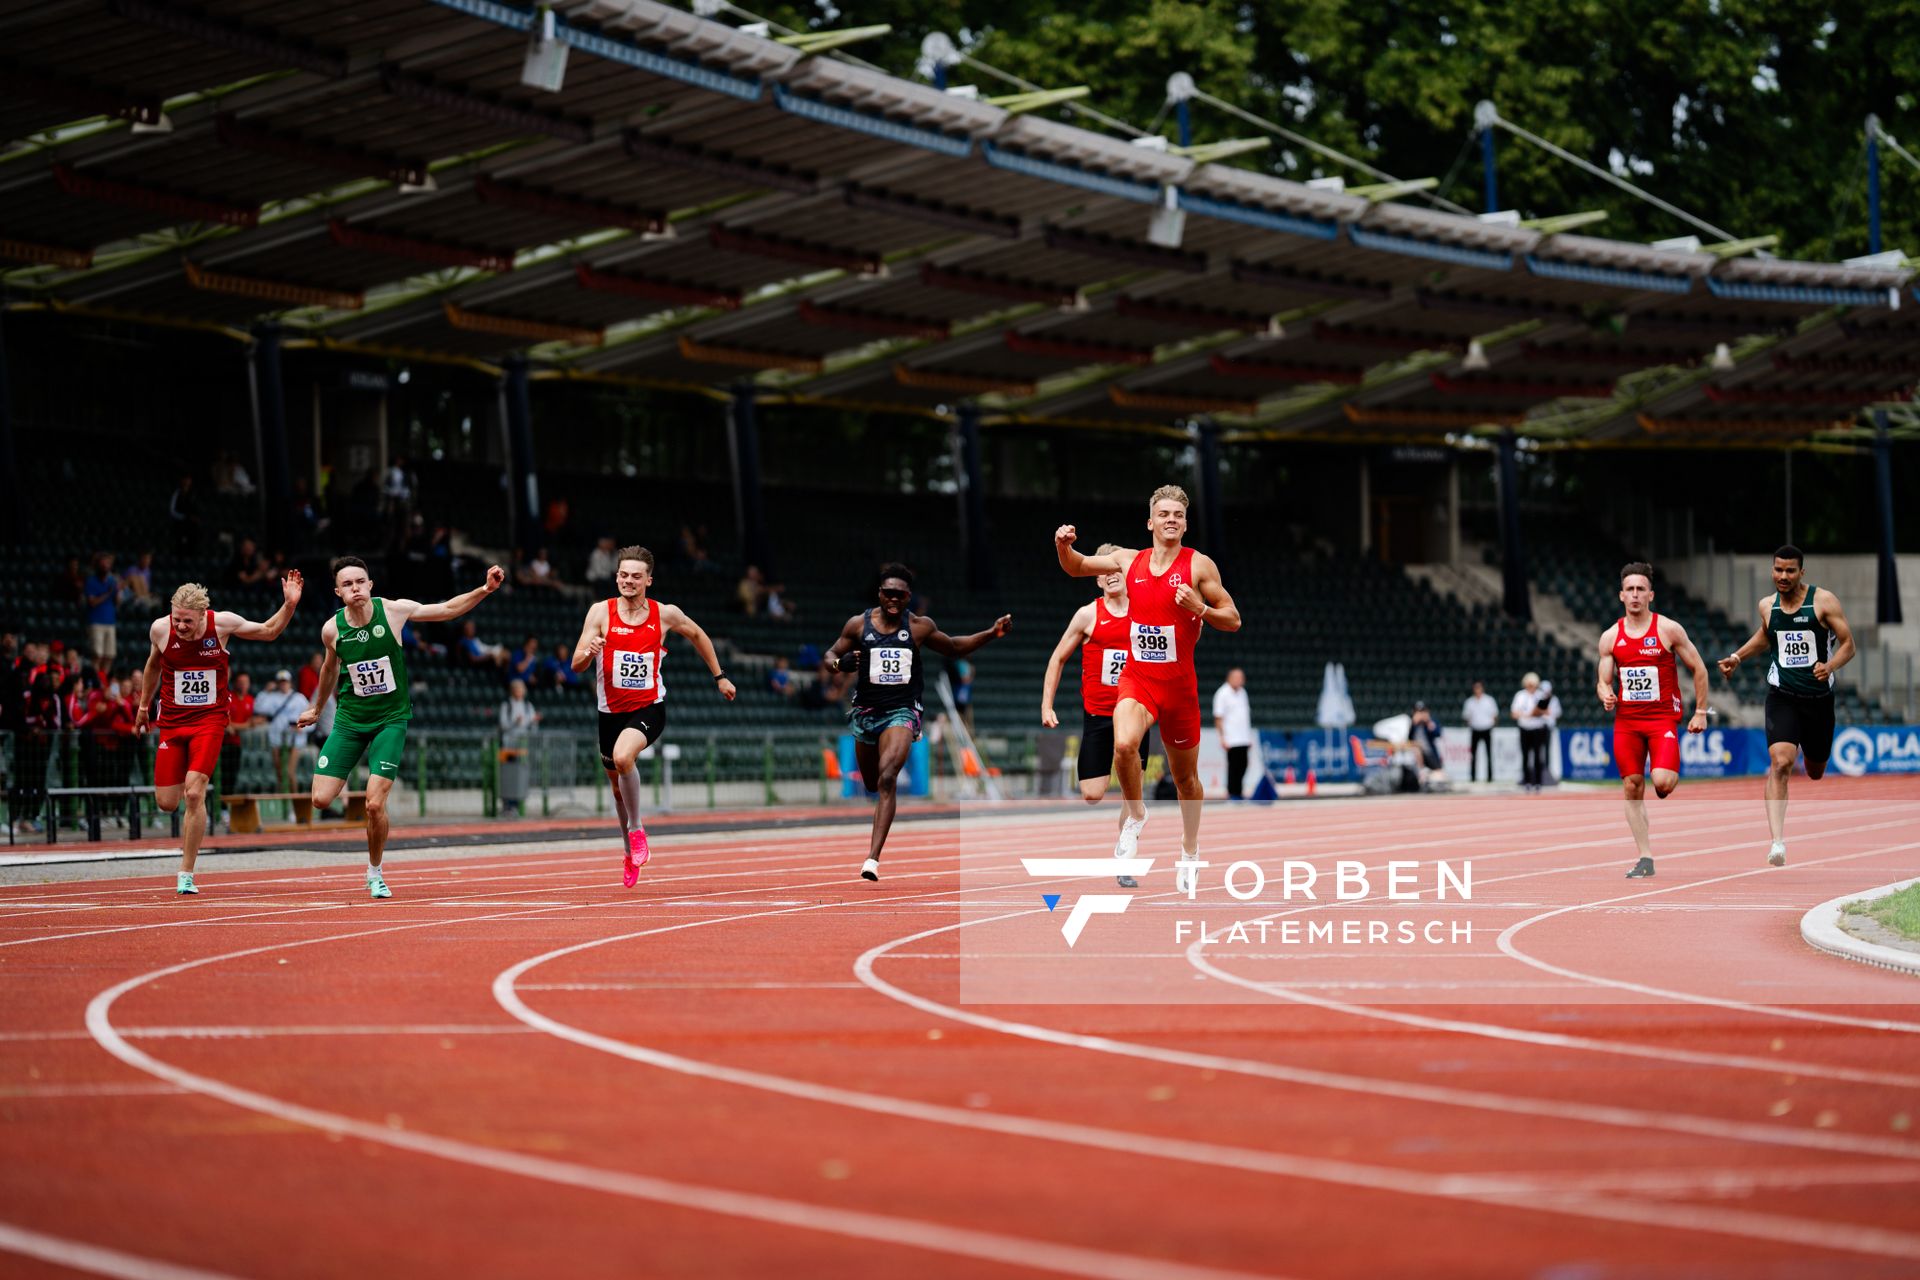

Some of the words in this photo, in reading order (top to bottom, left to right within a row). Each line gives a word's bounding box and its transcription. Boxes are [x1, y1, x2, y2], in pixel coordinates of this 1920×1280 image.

[1138, 636, 1168, 650] 398
[1785, 633, 1804, 641] GLS
[880, 650, 900, 658] GLS
[1784, 642, 1810, 656] 489
[623, 654, 644, 663] GLS
[357, 662, 378, 672] GLS
[620, 664, 648, 678] 523
[882, 660, 900, 673] 93
[183, 672, 204, 680] GLS
[358, 669, 384, 686] 317
[1627, 669, 1646, 678] GLS
[182, 681, 210, 694] 248
[1627, 678, 1652, 691] 252
